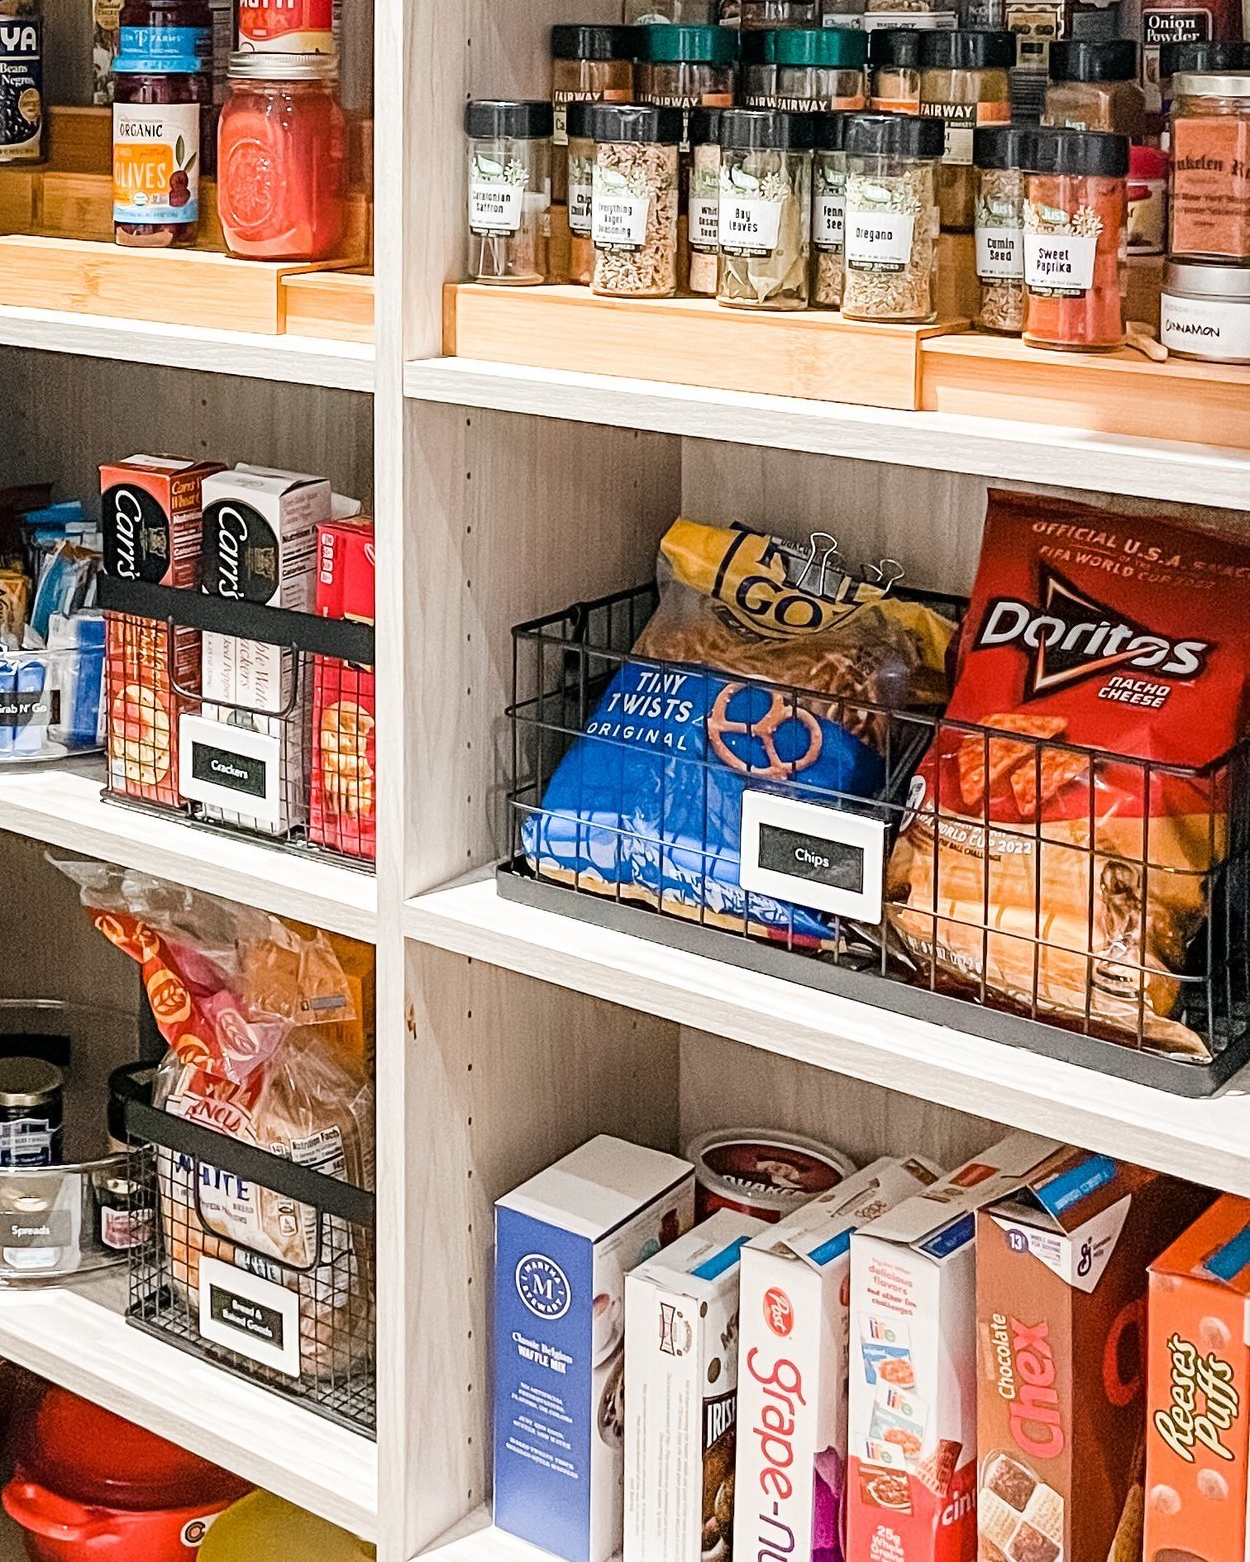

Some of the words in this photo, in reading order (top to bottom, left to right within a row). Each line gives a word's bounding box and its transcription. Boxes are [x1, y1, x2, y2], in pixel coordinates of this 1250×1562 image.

[1148, 15, 1196, 29] Onion
[1146, 28, 1201, 42] Powder
[0, 62, 28, 74] Beans
[555, 90, 601, 103] FAIRWAY
[777, 97, 828, 112] FAIRWAY
[920, 102, 973, 119] FAIRWAY
[119, 123, 163, 138] ORGANIC
[114, 162, 167, 189] OLIVES
[476, 201, 504, 214] Saffron
[598, 202, 633, 216] Everything
[735, 207, 752, 223] Bay
[597, 224, 631, 238] Seasoning
[855, 227, 894, 243] Oregano
[987, 237, 1015, 250] Cumin
[989, 250, 1012, 262] Seed
[1038, 247, 1069, 261] Sweet
[1036, 260, 1072, 275] Paprika
[1165, 319, 1221, 338] CINNAMON
[114, 489, 142, 580] Carr's
[1032, 521, 1117, 549] OFFICIAL
[218, 506, 248, 600] Carr's
[1039, 545, 1072, 561] FIFA
[1075, 551, 1135, 577] WORLD
[980, 600, 1209, 675] Doritos
[636, 671, 688, 697] TINY
[1107, 676, 1171, 696] NACHO
[32, 702, 48, 714] Go
[1097, 687, 1166, 709] CHEESE
[607, 693, 695, 724] TWISTS
[586, 722, 688, 751] ORIGINAL
[210, 759, 250, 780] Crackers
[997, 838, 1033, 855] 2022
[794, 846, 830, 869] Chips
[11, 1224, 51, 1238] Spreads
[532, 1272, 555, 1301] M
[868, 1264, 914, 1290] delicious
[872, 1274, 909, 1297] flavors
[518, 1343, 550, 1368] WAFFLE
[996, 1312, 1018, 1400] Chocolate
[1009, 1315, 1066, 1460] Chex
[1151, 1333, 1198, 1463] Reese's
[1191, 1352, 1241, 1462] Puffs
[871, 1533, 904, 1556] Whole
